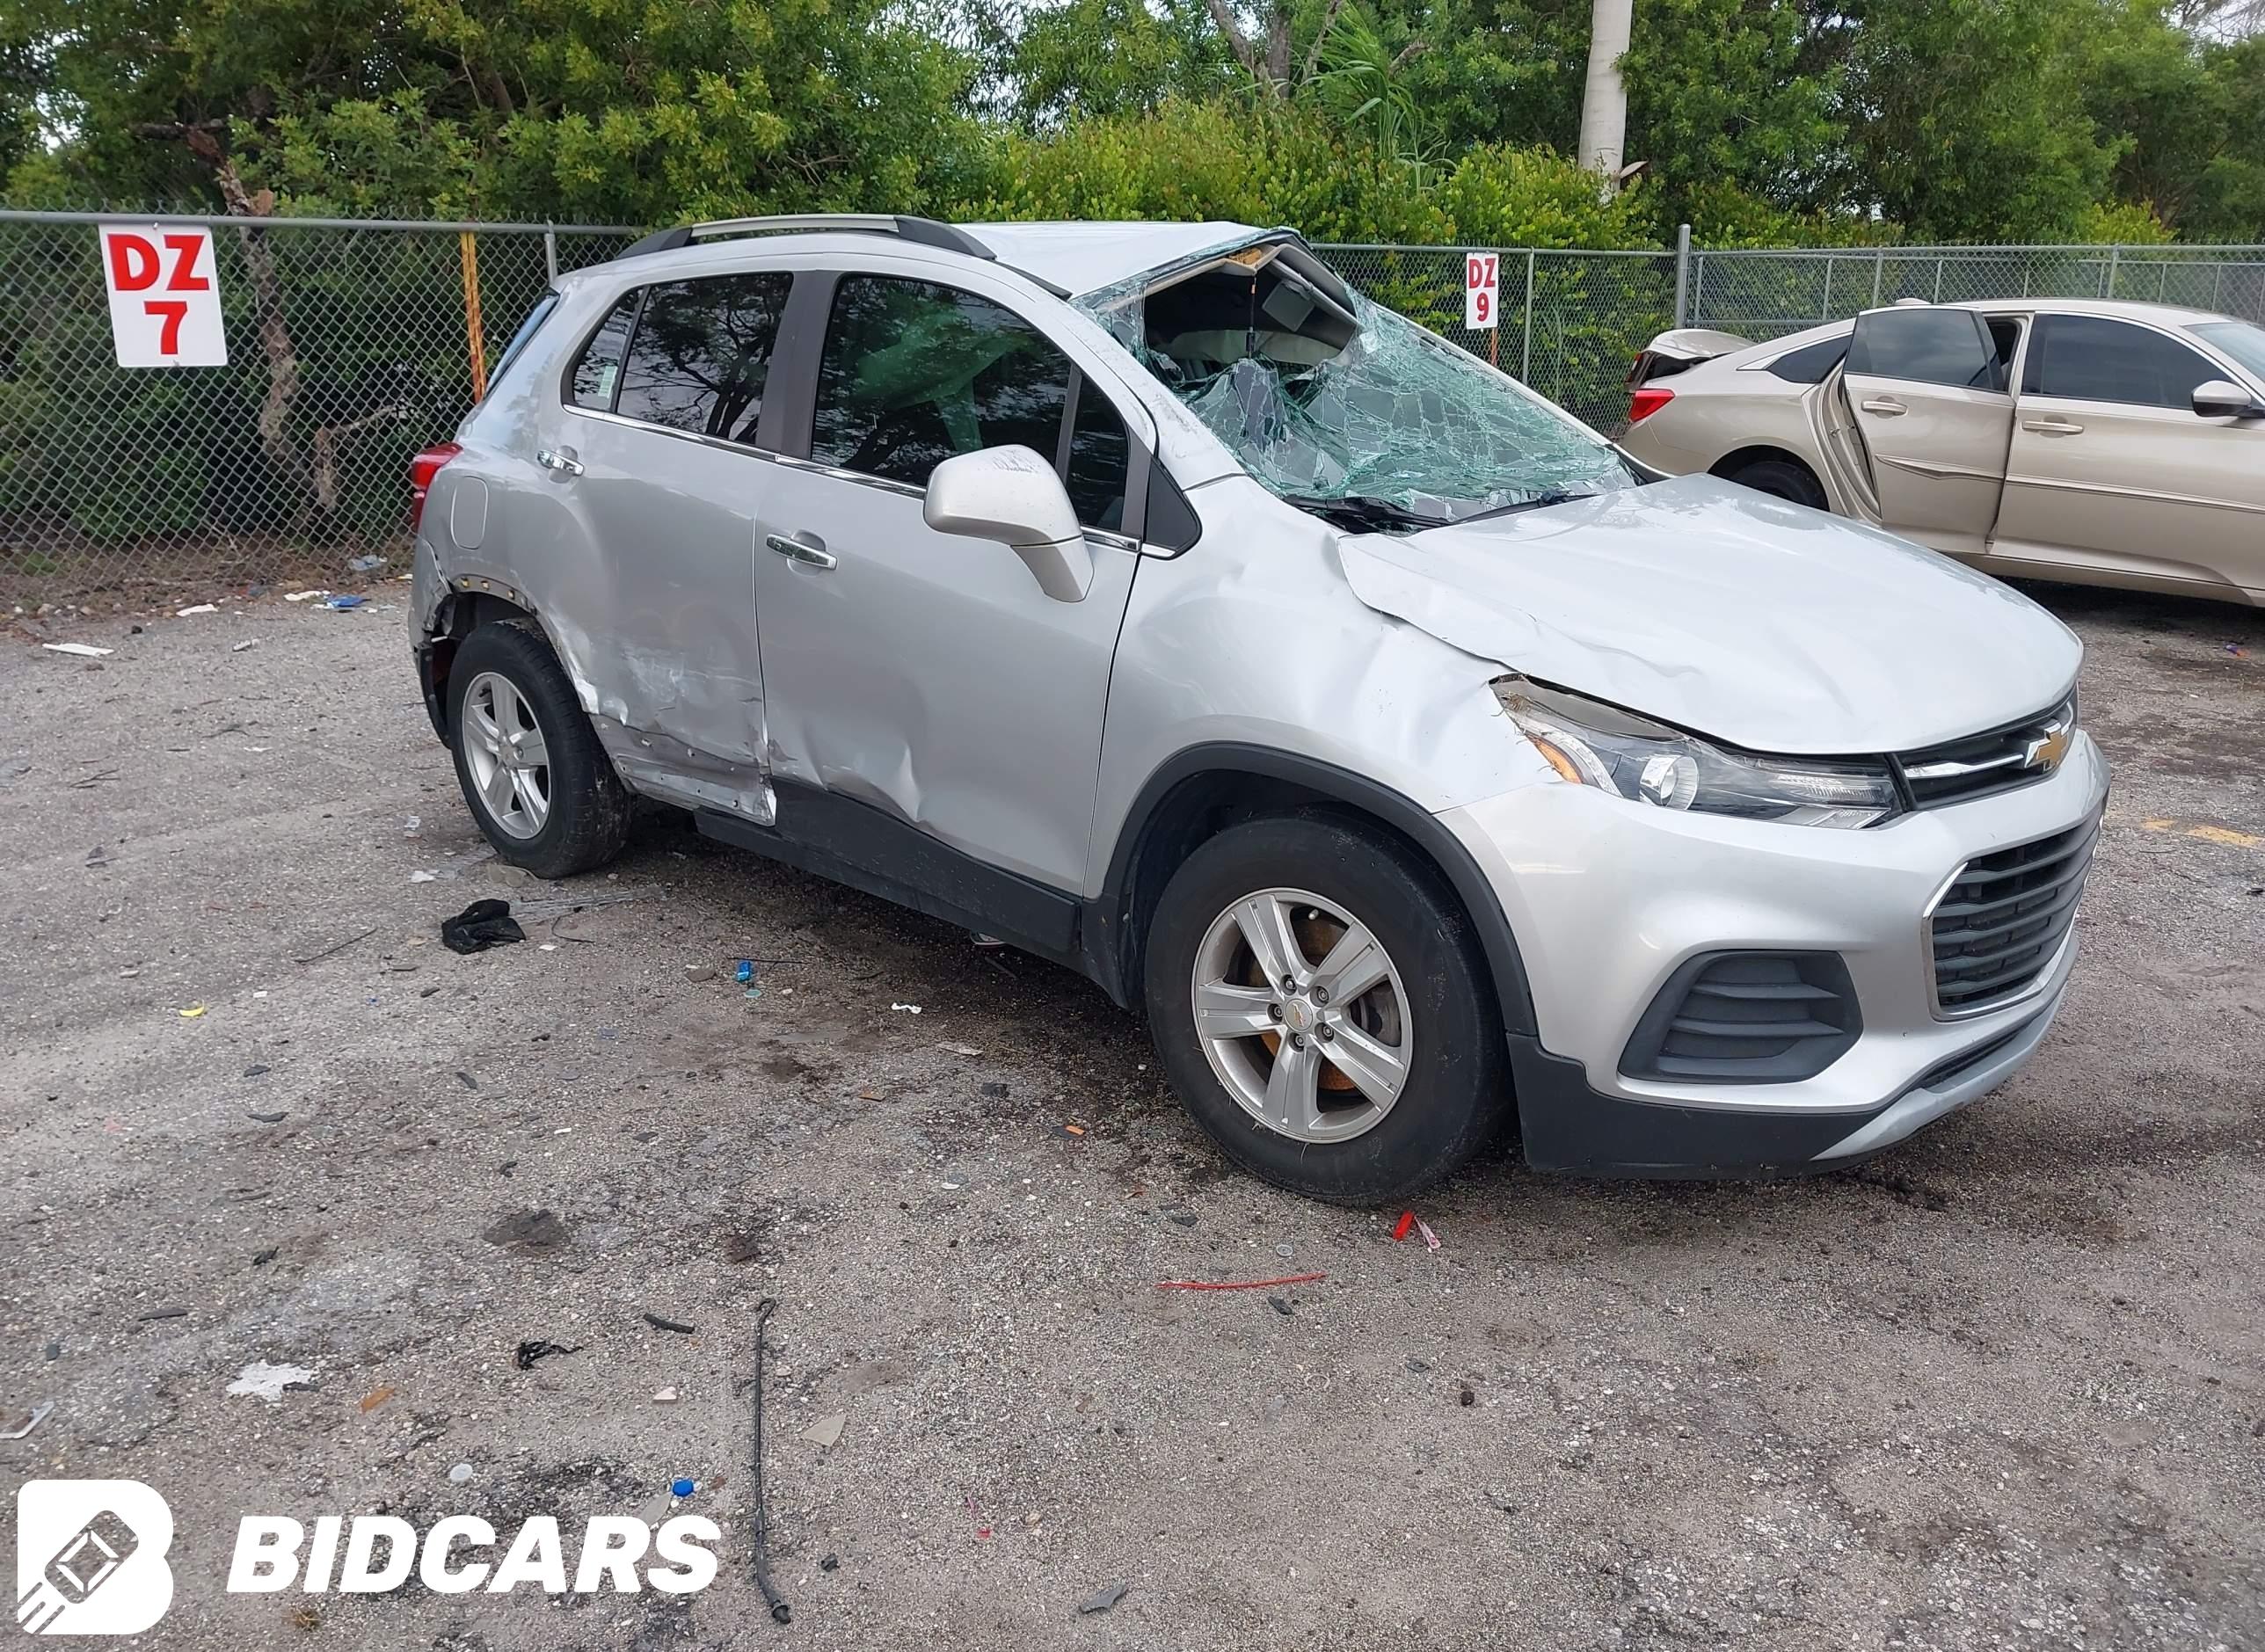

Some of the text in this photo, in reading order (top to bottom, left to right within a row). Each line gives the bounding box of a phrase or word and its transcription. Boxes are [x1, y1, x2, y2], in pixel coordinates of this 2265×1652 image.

[106, 233, 211, 292] DZ
[1468, 257, 1497, 289] DZ
[143, 300, 188, 355] 7
[1476, 292, 1489, 322] 9
